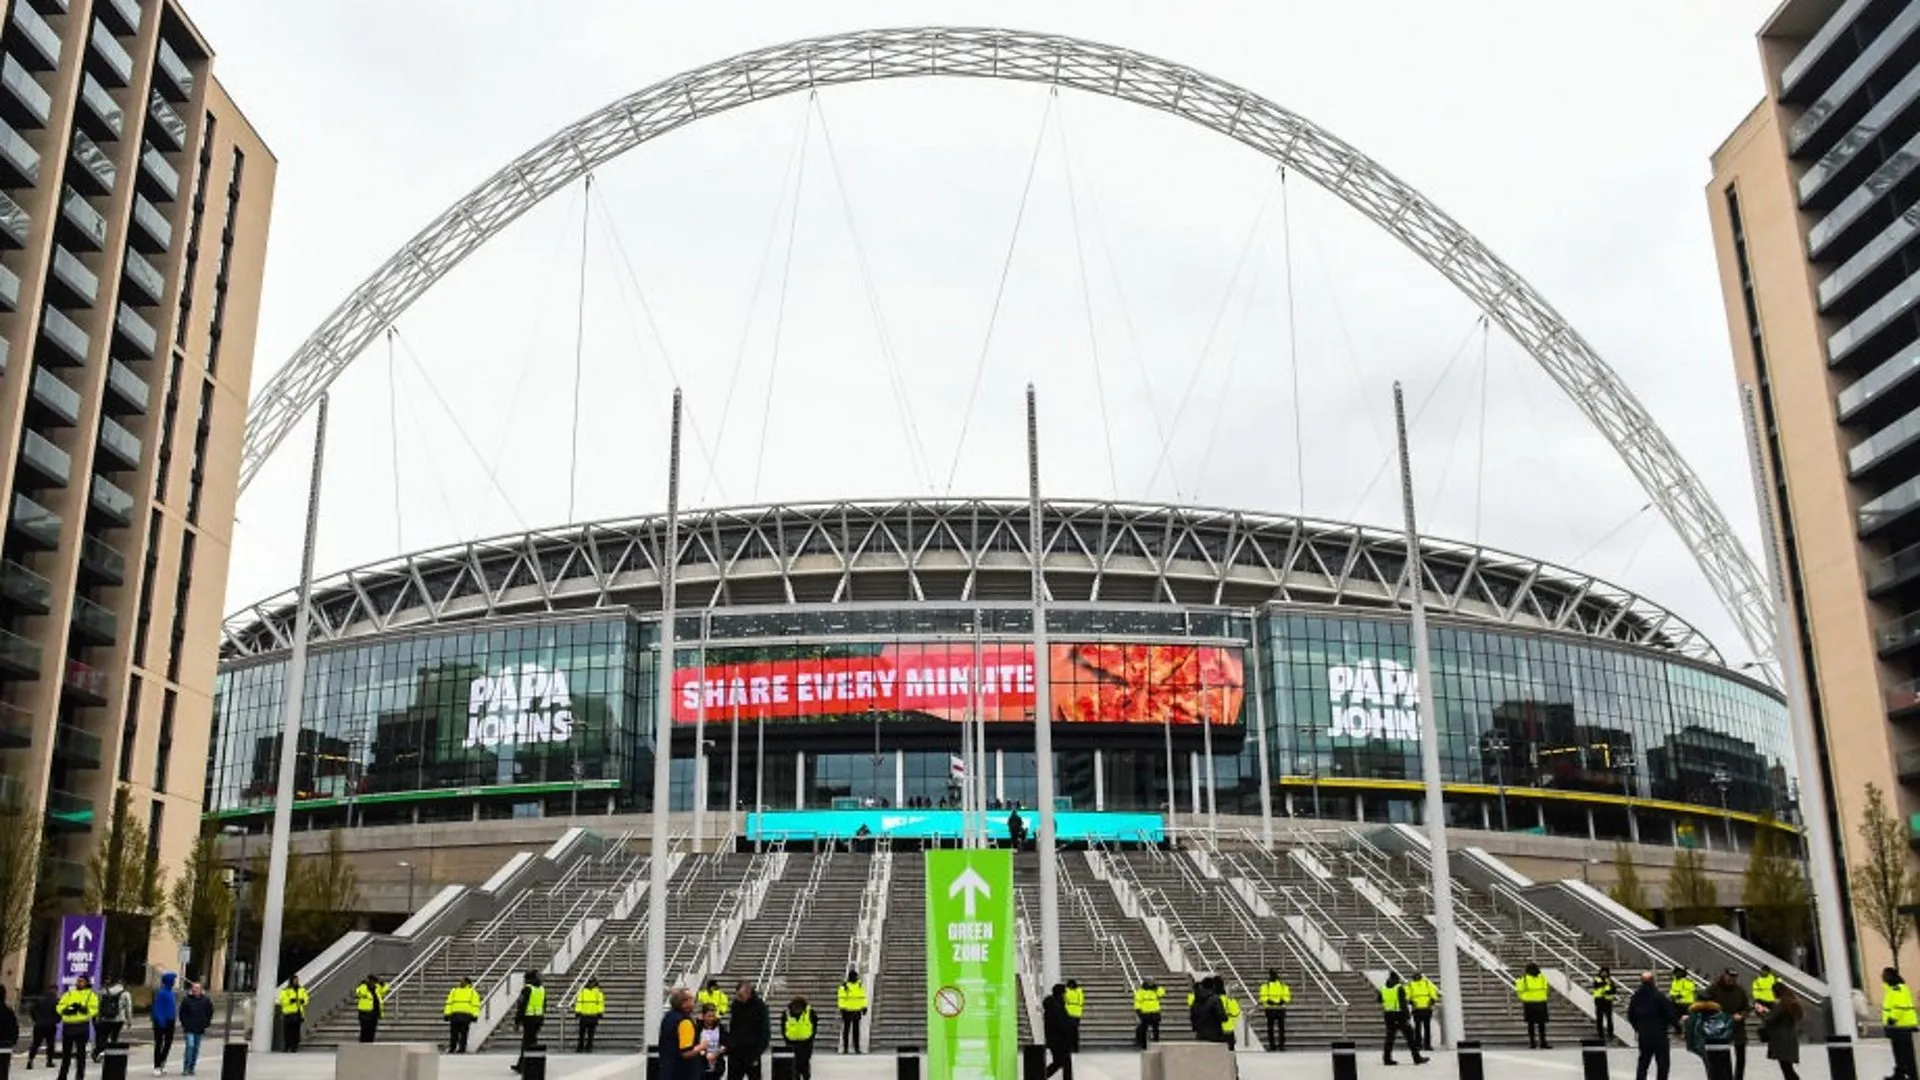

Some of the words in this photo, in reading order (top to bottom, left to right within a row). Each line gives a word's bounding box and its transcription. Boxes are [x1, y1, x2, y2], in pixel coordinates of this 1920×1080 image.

[469, 663, 572, 714] PAPA
[682, 674, 790, 709] SHARE
[797, 669, 897, 702] EVERY
[905, 664, 1035, 697] MINUTE
[463, 709, 573, 748] JOHNS
[1328, 705, 1423, 741] JOHN
[947, 921, 994, 941] GREEN
[951, 943, 990, 963] ZONE
